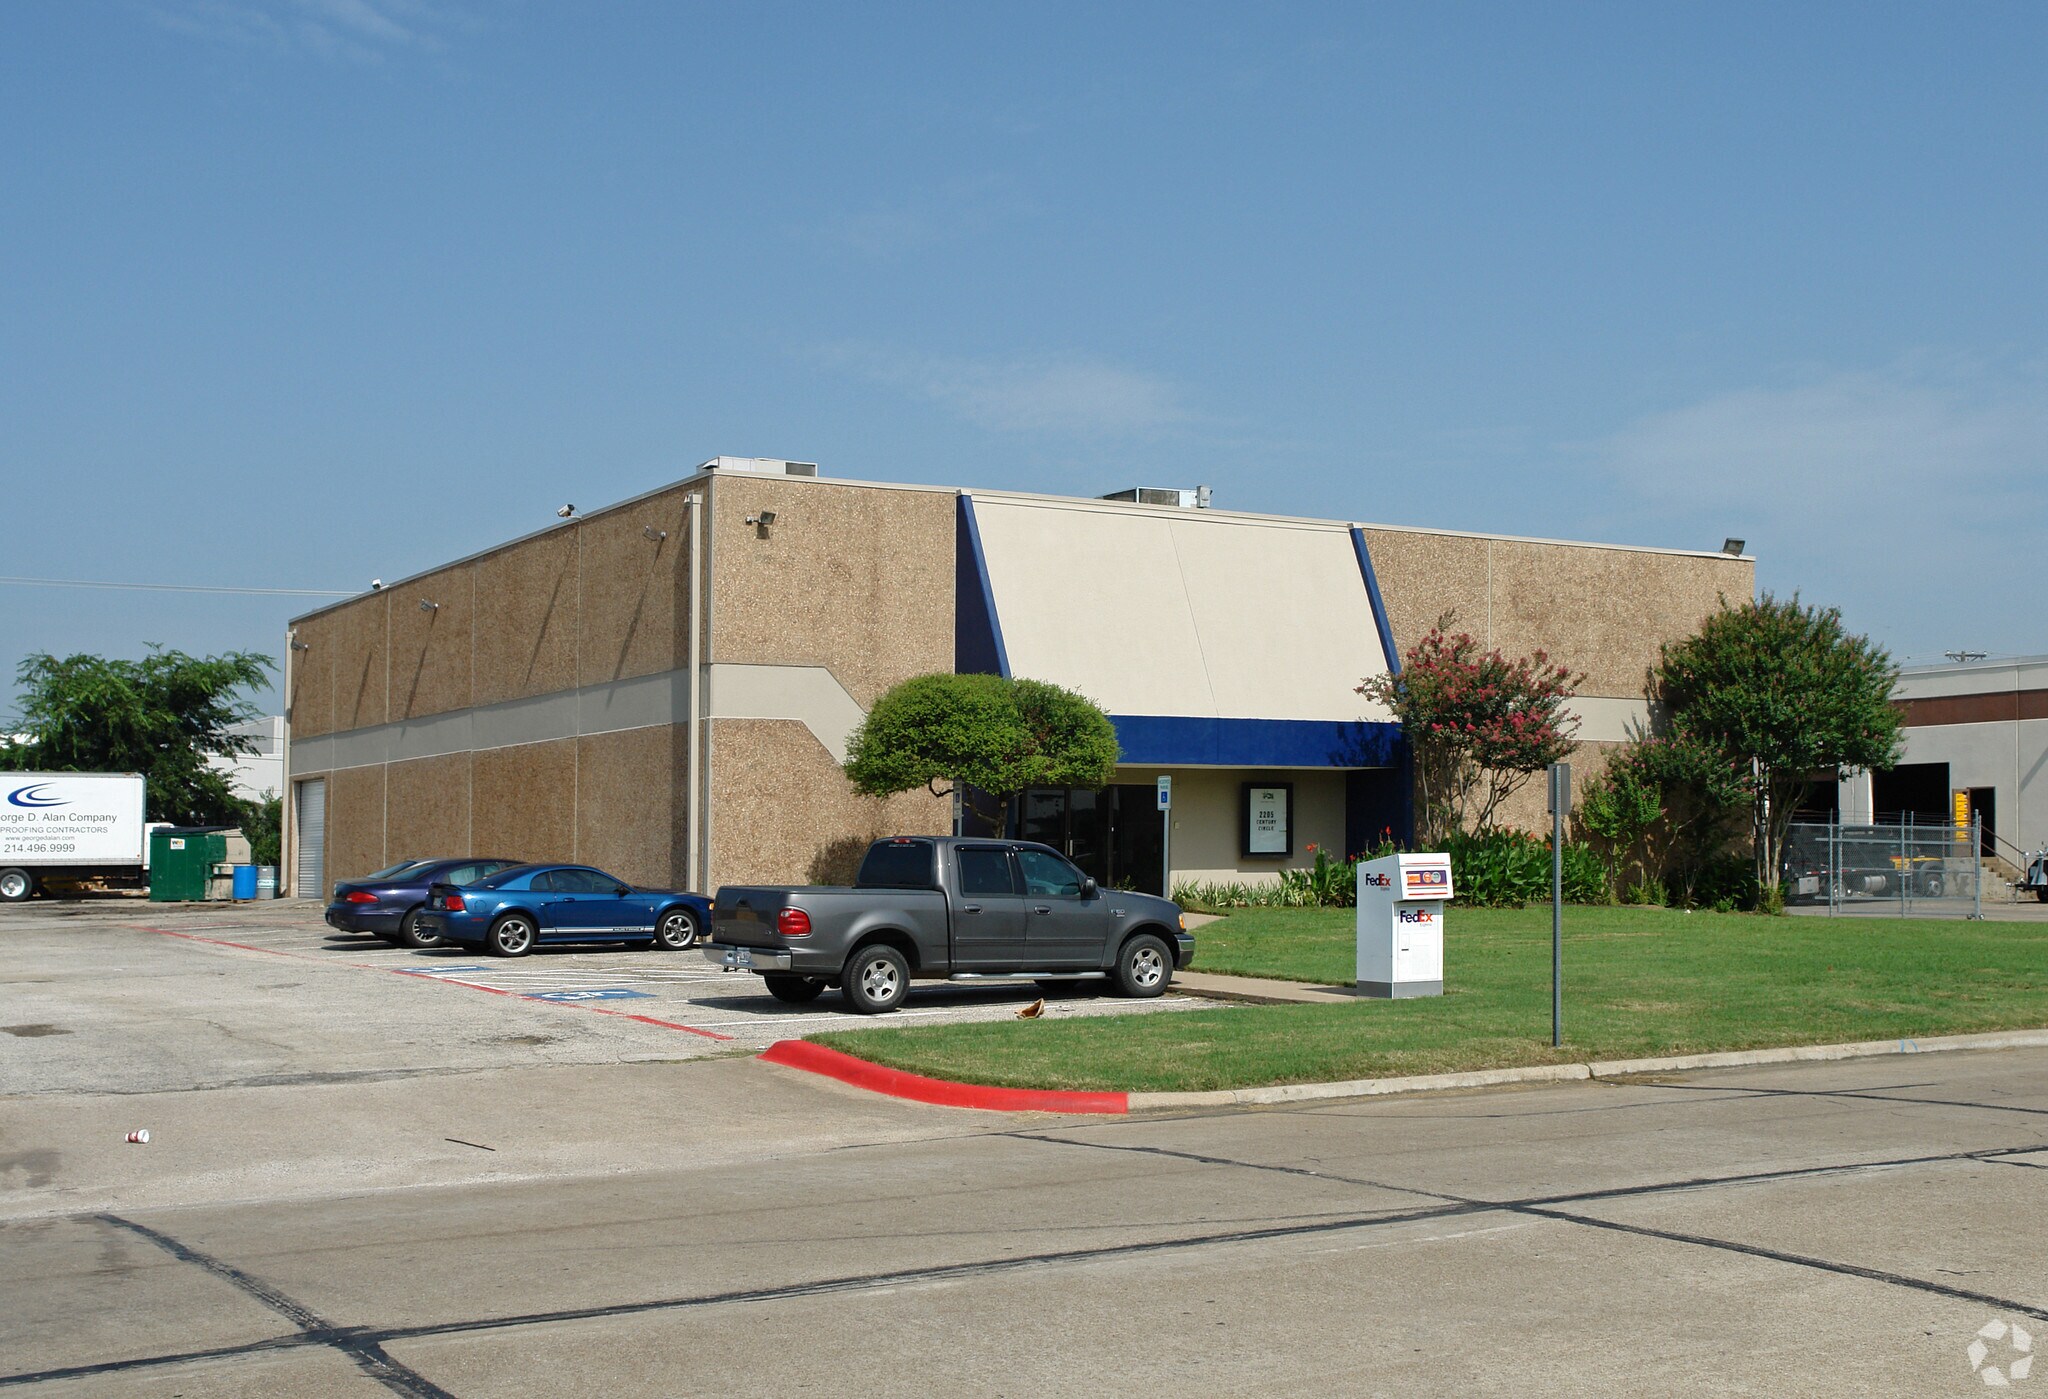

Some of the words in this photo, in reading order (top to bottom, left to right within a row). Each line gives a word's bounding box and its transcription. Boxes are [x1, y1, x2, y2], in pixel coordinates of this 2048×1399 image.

[27, 812, 39, 822] D.
[42, 812, 66, 822] Alan
[68, 812, 118, 824] Company
[46, 826, 109, 834] CONTRACTORS
[4, 843, 76, 853] 214.496.9999
[1365, 873, 1391, 887] FedEx
[1400, 909, 1433, 923] FedEx
